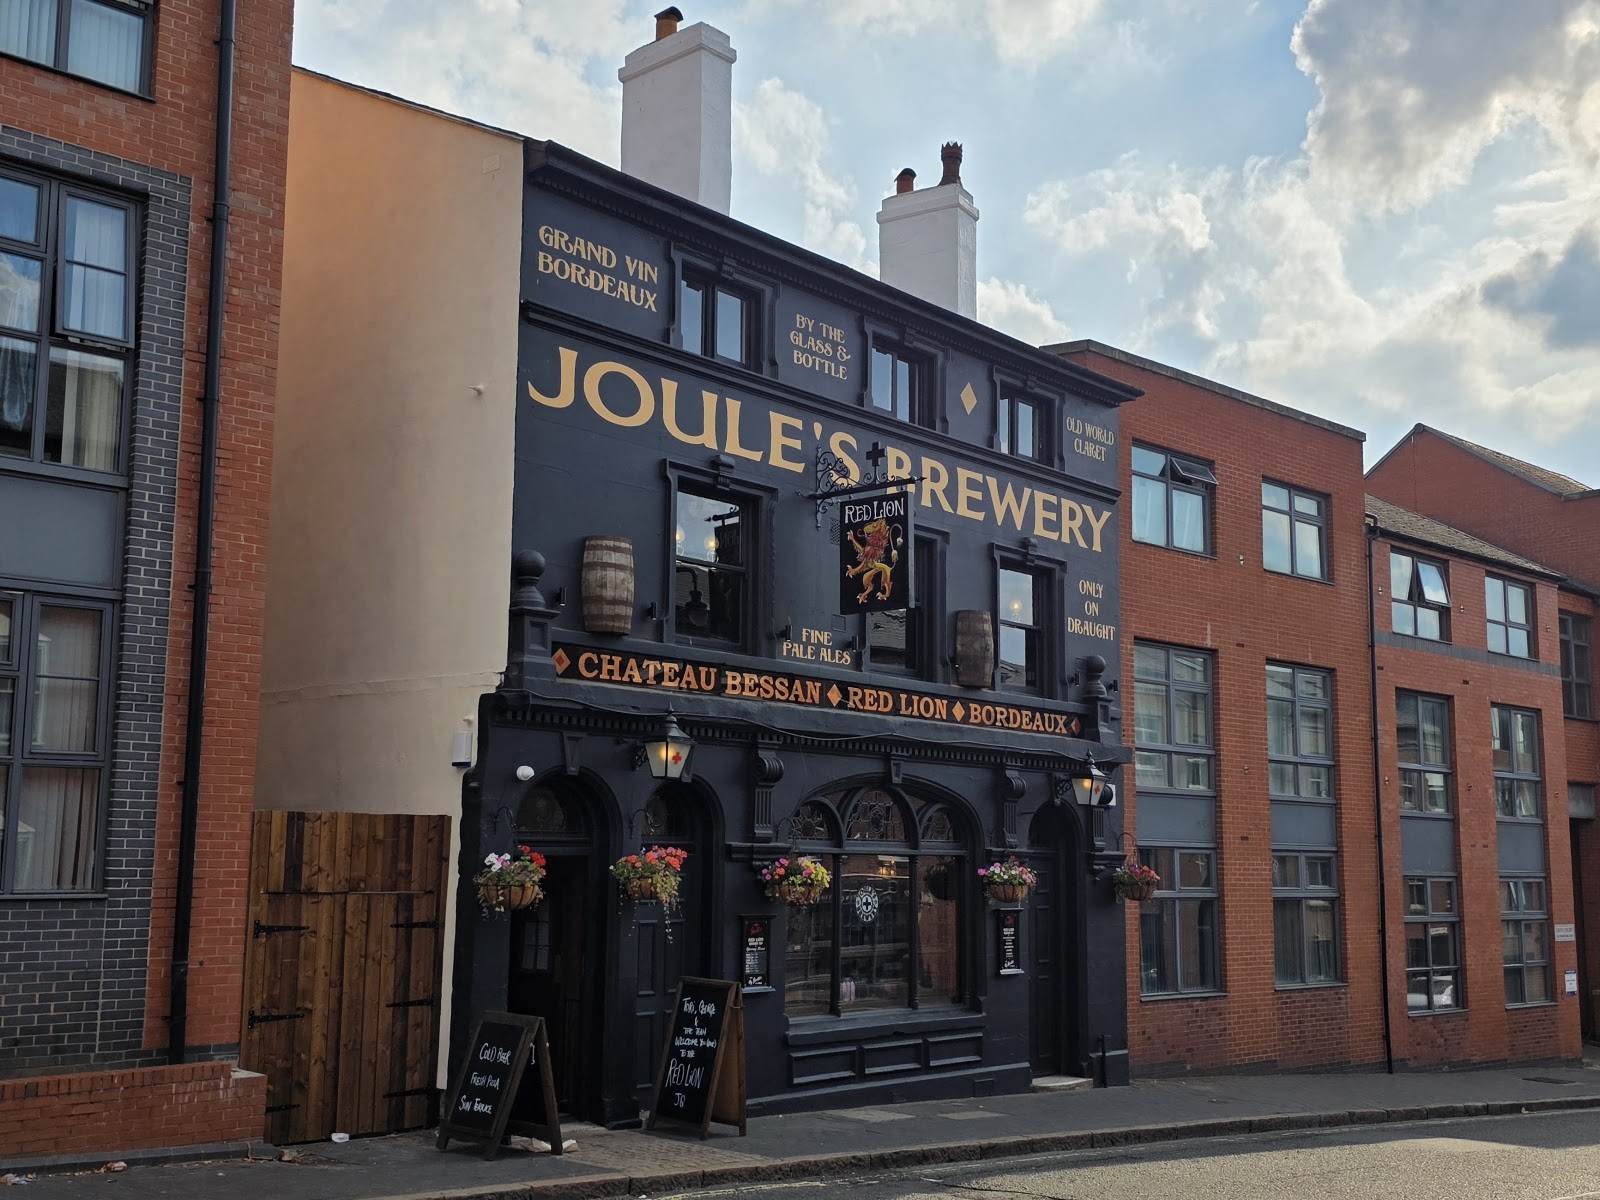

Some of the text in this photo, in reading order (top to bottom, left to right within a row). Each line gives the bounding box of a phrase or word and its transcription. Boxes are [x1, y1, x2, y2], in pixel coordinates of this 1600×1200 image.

[538, 225, 658, 285] GRAND VIN
[538, 251, 657, 312] BORDEAUX
[796, 313, 846, 343] BY THE
[790, 330, 851, 361] GLASS &
[793, 349, 847, 380] BOTTLE
[1066, 416, 1114, 445] OLD WORLD
[528, 346, 1112, 552] JOULE'S BREWERY
[1074, 437, 1106, 461] CLARET
[844, 497, 904, 524] RED LION
[1079, 579, 1104, 598] ONLY
[1085, 600, 1099, 616] ON
[802, 627, 832, 646] FINE
[1067, 616, 1115, 640] DRAUGHT
[782, 641, 851, 665] PALE ALES
[578, 652, 1068, 735] CHATEAU BESSAN RED LION BORDEAUX
